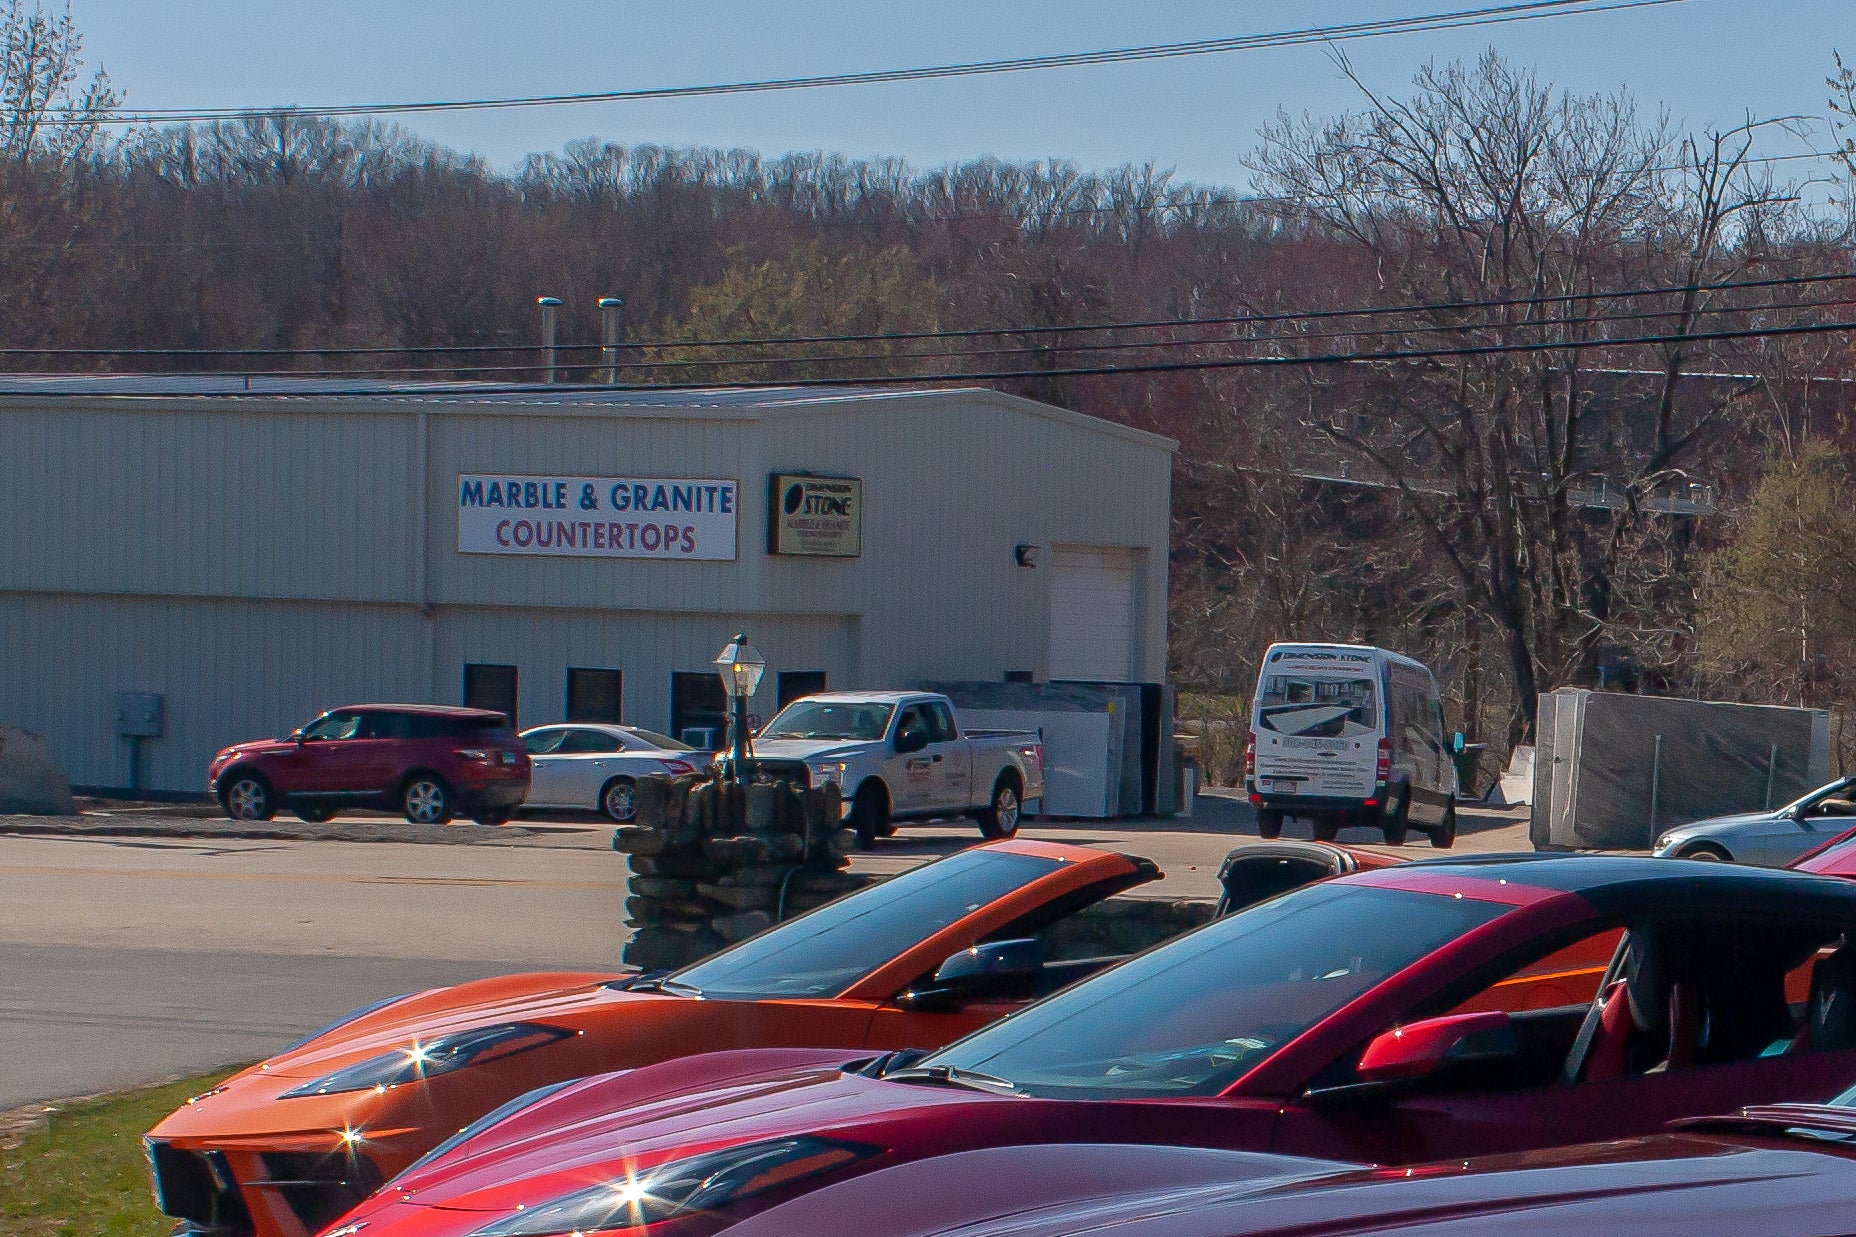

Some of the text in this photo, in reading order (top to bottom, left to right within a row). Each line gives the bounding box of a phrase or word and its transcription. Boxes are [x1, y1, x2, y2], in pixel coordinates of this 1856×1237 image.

[460, 480, 733, 514] MARBLE & GRANITE
[803, 495, 853, 516] STONE
[495, 519, 696, 554] COUNTERTOPS
